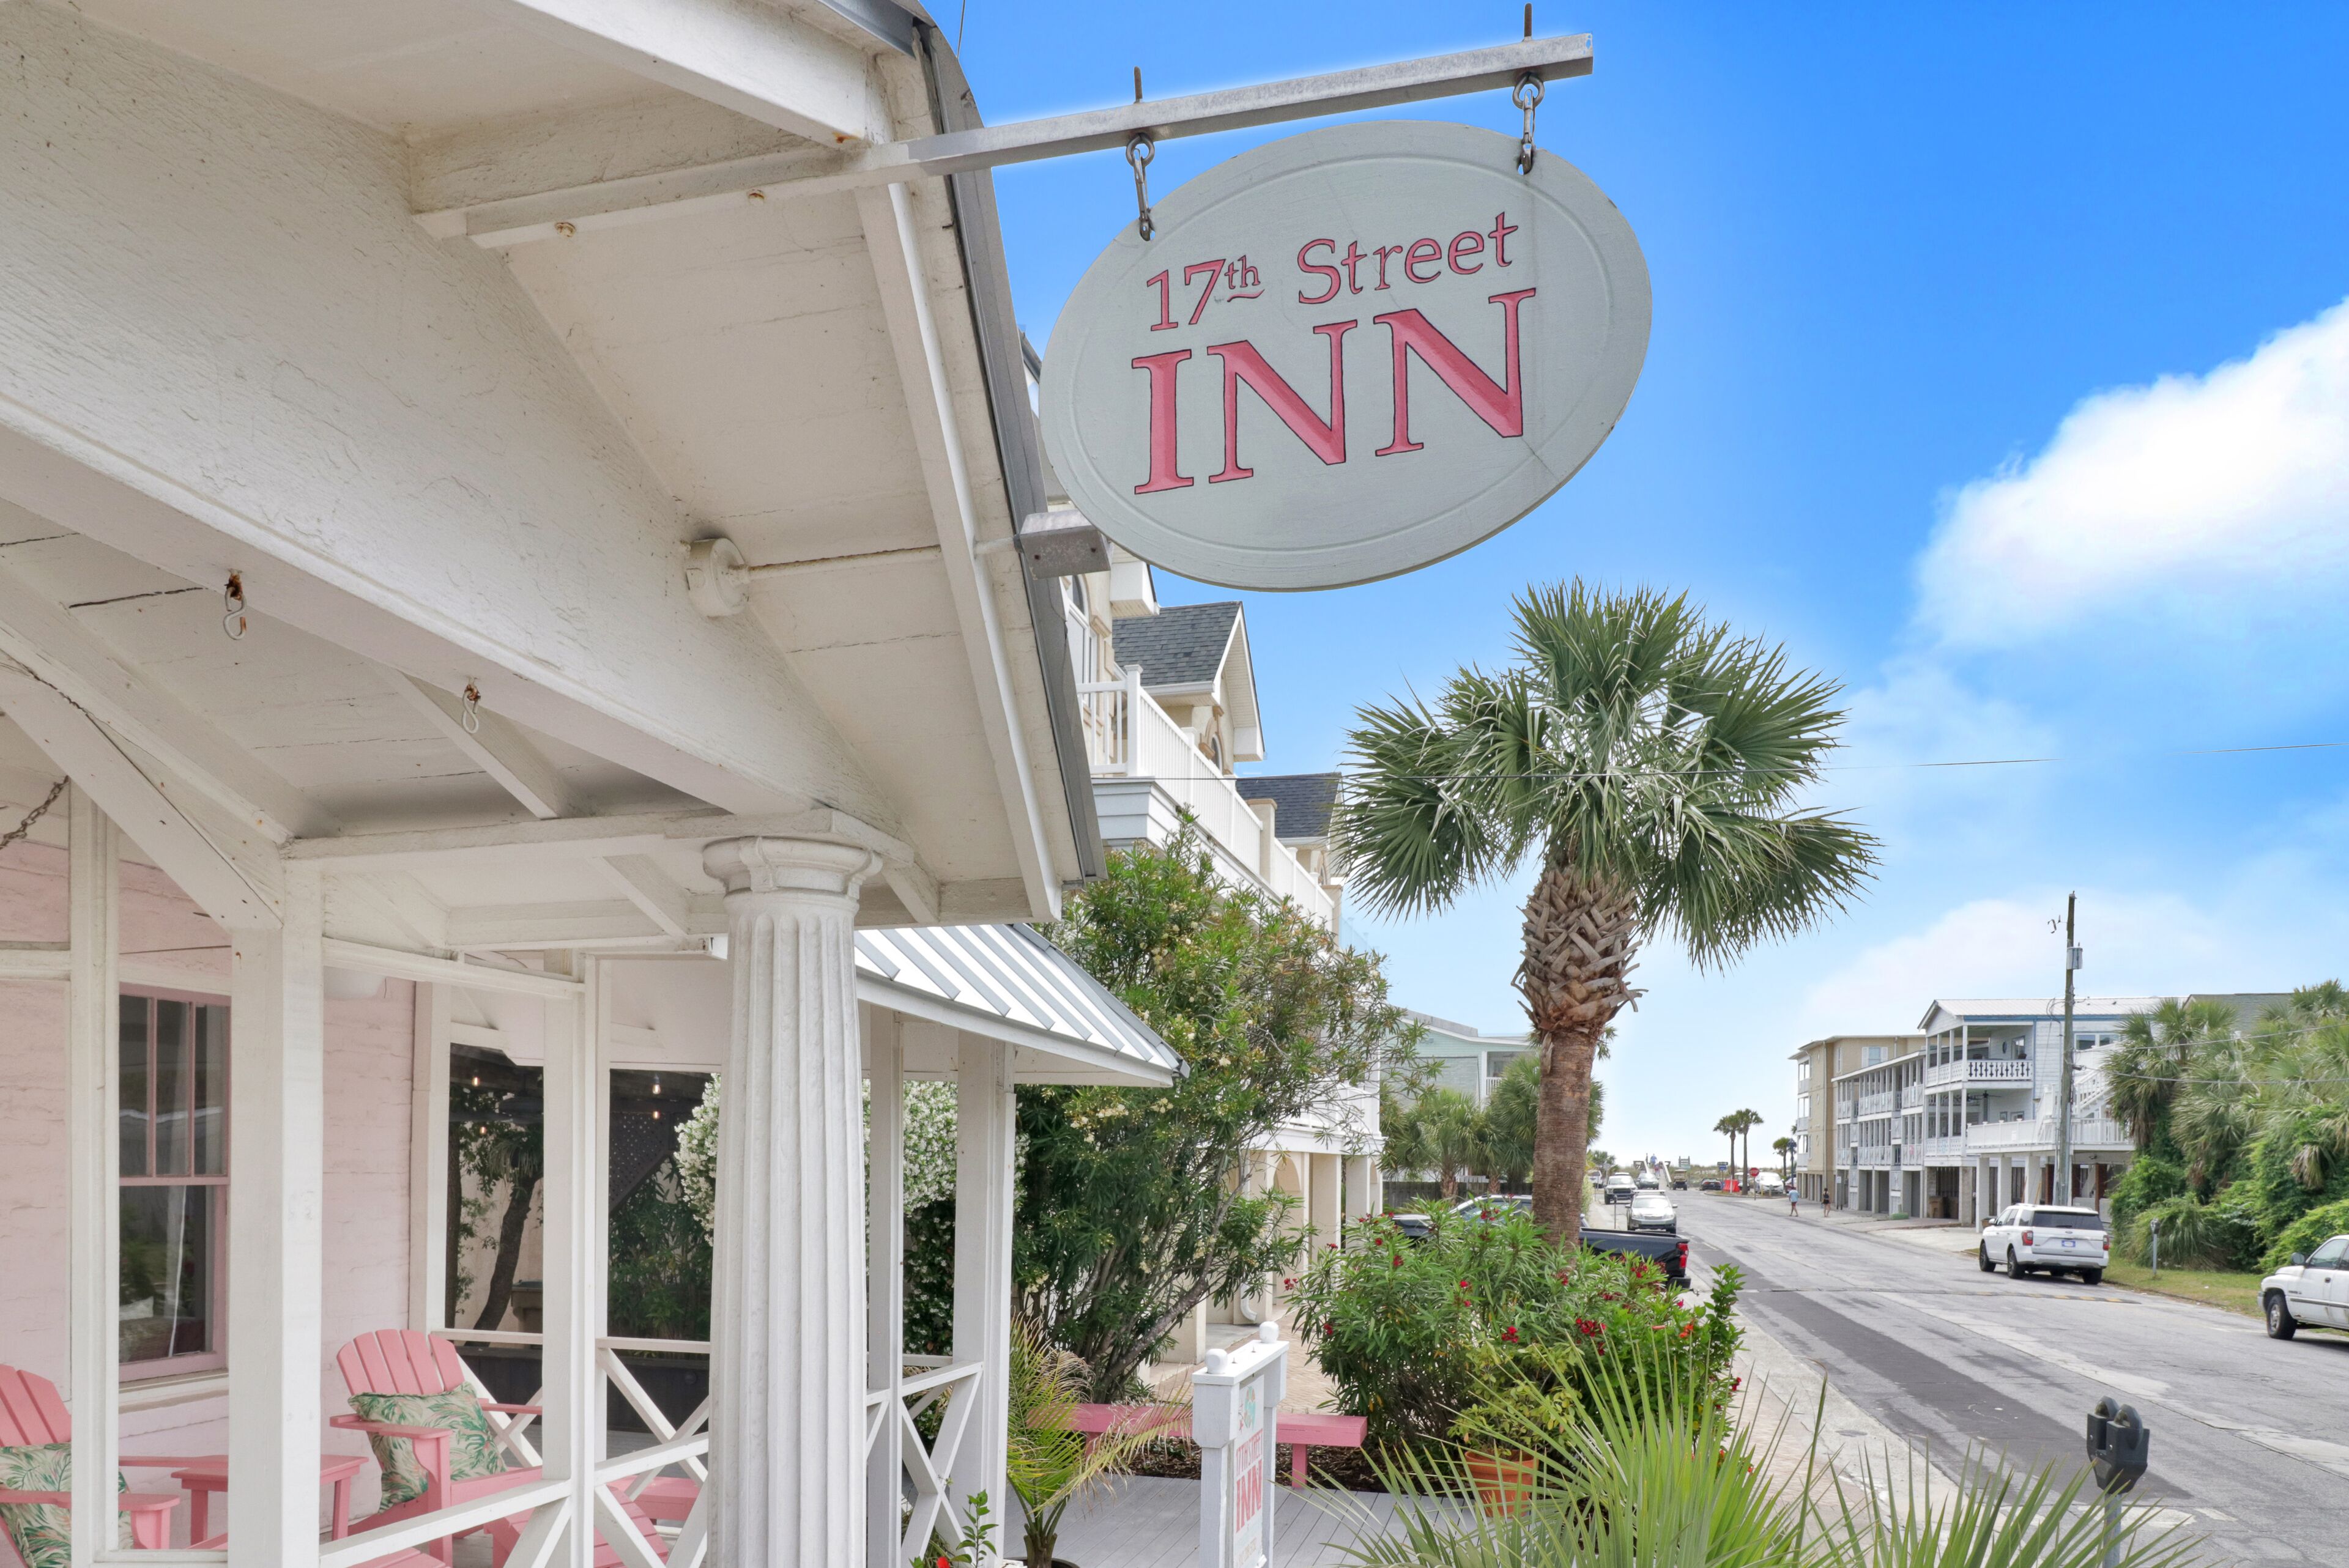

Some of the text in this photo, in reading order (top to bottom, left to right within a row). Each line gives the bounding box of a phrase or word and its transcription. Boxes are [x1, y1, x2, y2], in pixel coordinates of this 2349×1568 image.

[1146, 212, 1519, 332] 17th Street
[1131, 287, 1536, 495] INN
[1236, 1428, 1263, 1477] 17TH STREET
[1236, 1459, 1263, 1533] INN
